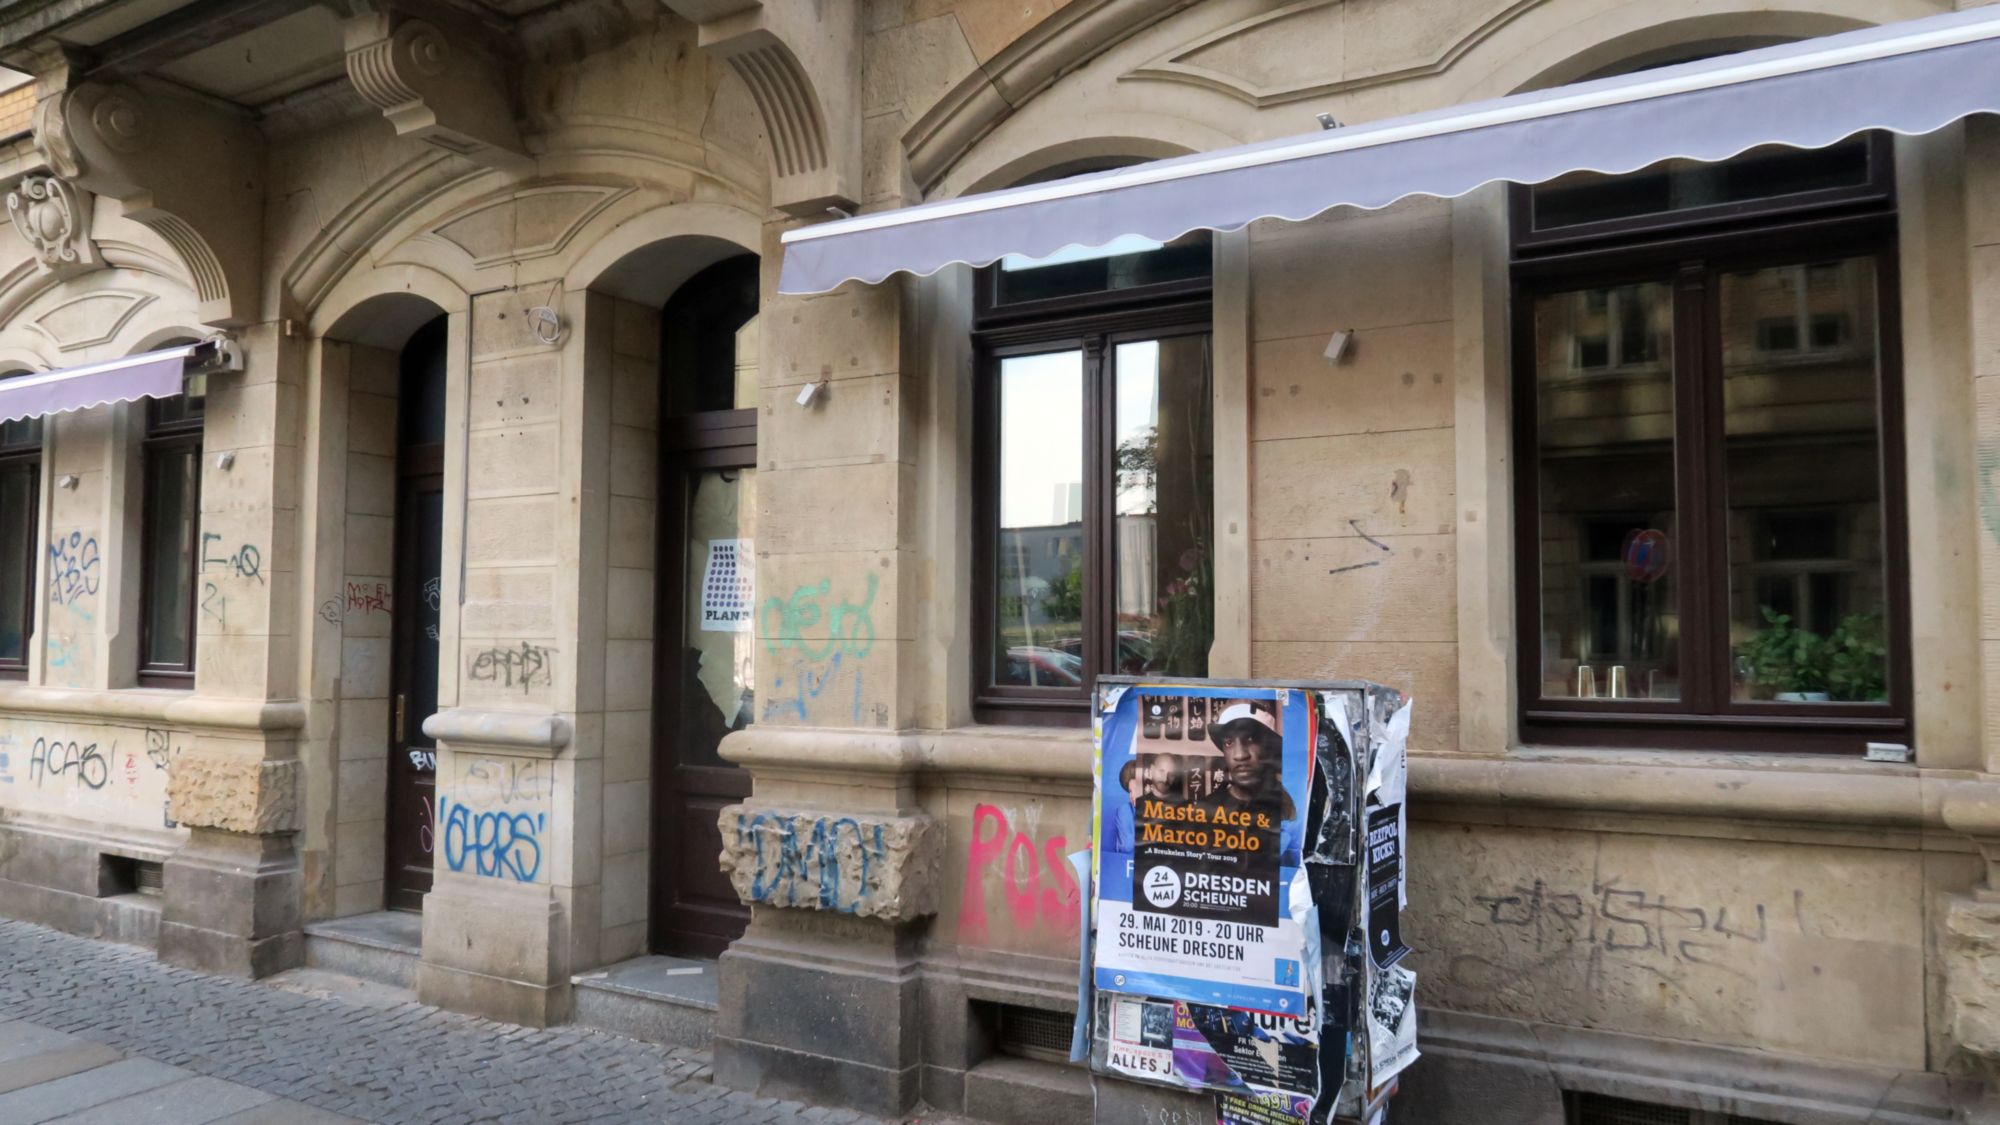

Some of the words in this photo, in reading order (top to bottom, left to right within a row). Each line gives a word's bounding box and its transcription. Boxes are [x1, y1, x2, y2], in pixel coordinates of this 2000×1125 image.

[706, 610, 740, 621] PLAN
[1143, 800, 1206, 823] Masta
[1212, 806, 1251, 826] Ace
[1256, 813, 1270, 828] &
[1142, 823, 1207, 846] Marco
[1213, 829, 1260, 851] Polo
[1206, 853, 1221, 861] Tour
[1154, 872, 1169, 883] 24
[1184, 872, 1271, 896] DRESDEN
[1152, 890, 1174, 901] MAI
[1183, 889, 1247, 908] SCHEUNE
[1119, 913, 1138, 929] 29.
[1143, 916, 1166, 933] MAI
[1171, 918, 1203, 936] 2019
[1216, 923, 1232, 940] 20
[1237, 925, 1264, 943] UHR
[1119, 932, 1178, 953] SCHEUNE
[1183, 939, 1244, 961] DRESDEN
[1112, 1052, 1157, 1072] ALLES
